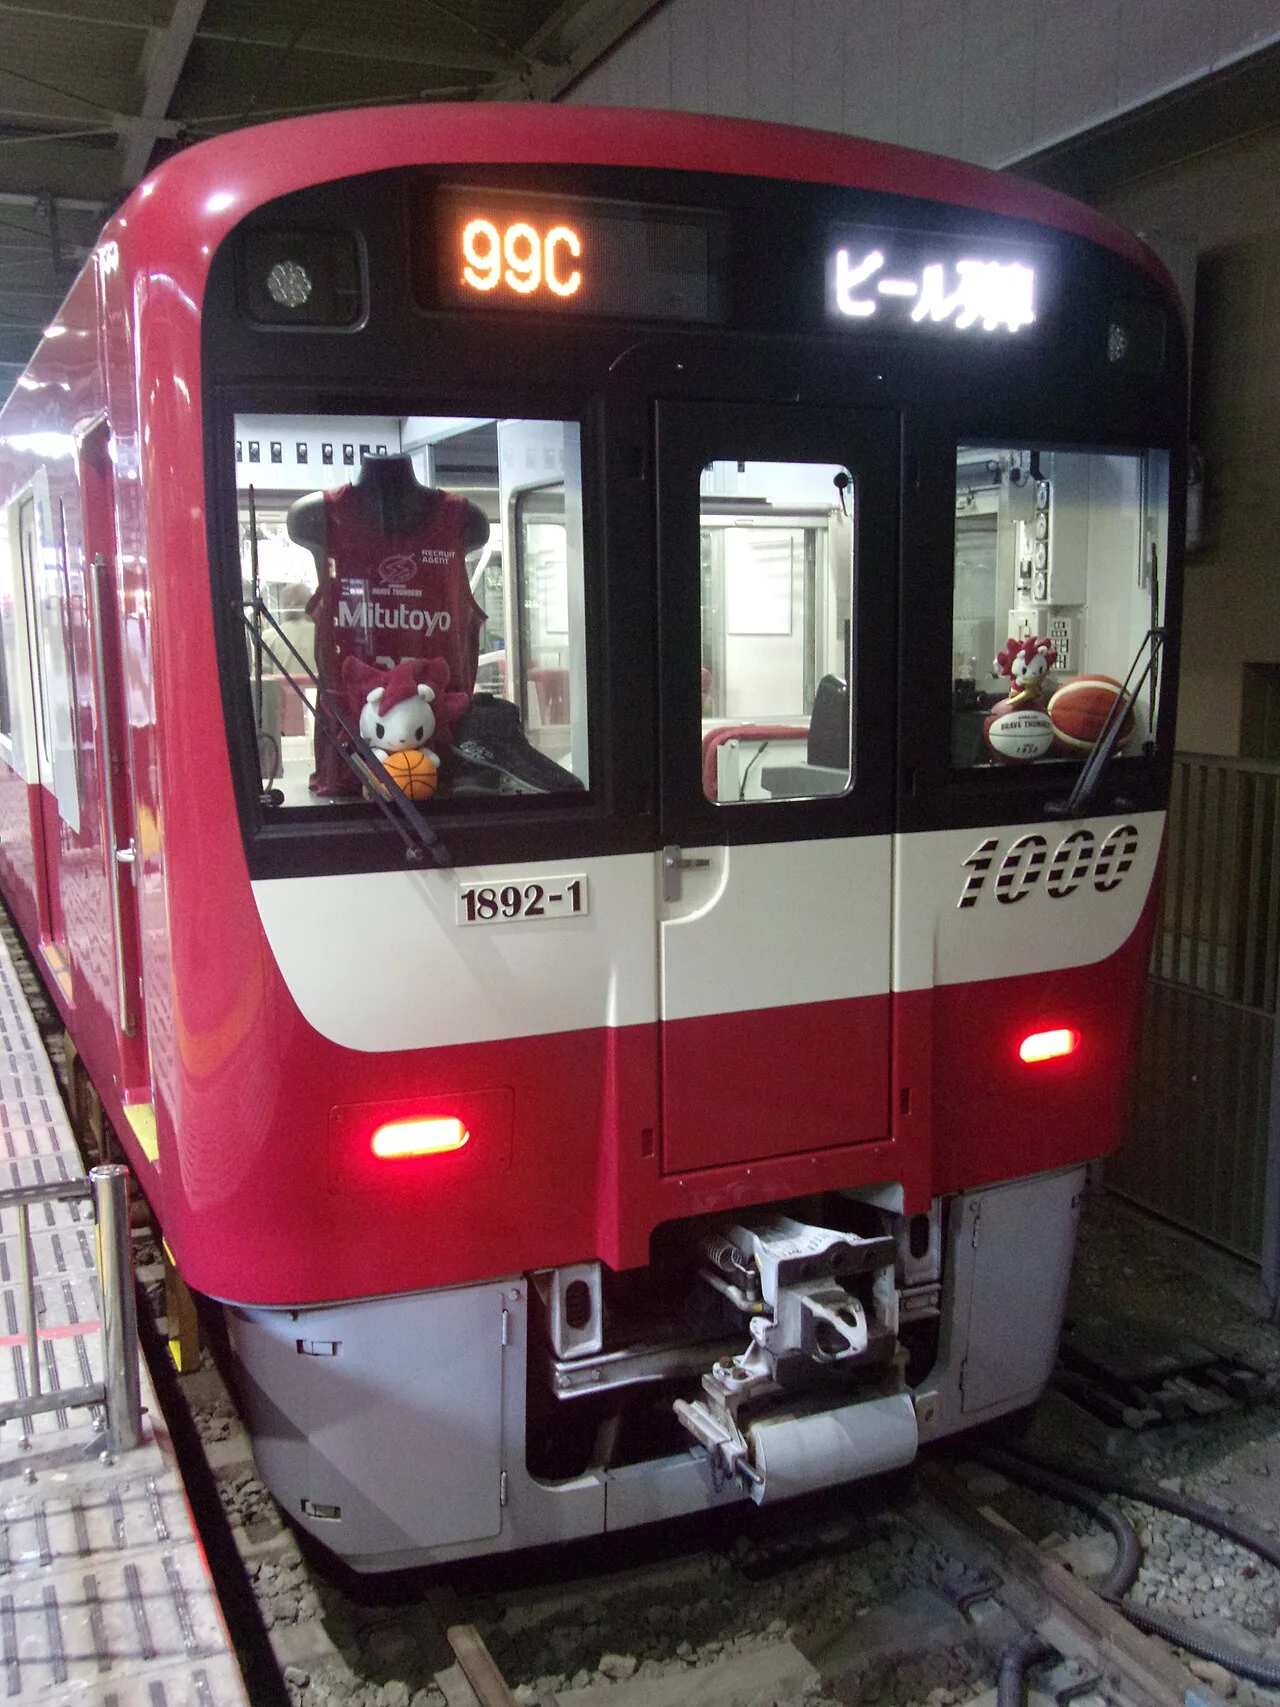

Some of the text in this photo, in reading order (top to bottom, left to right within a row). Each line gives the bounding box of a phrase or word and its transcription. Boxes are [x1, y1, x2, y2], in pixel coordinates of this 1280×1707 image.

[463, 219, 581, 297] 99C
[338, 600, 451, 638] Mitutoyo
[957, 824, 1139, 909] 1000
[460, 880, 581, 921] 1892-1
